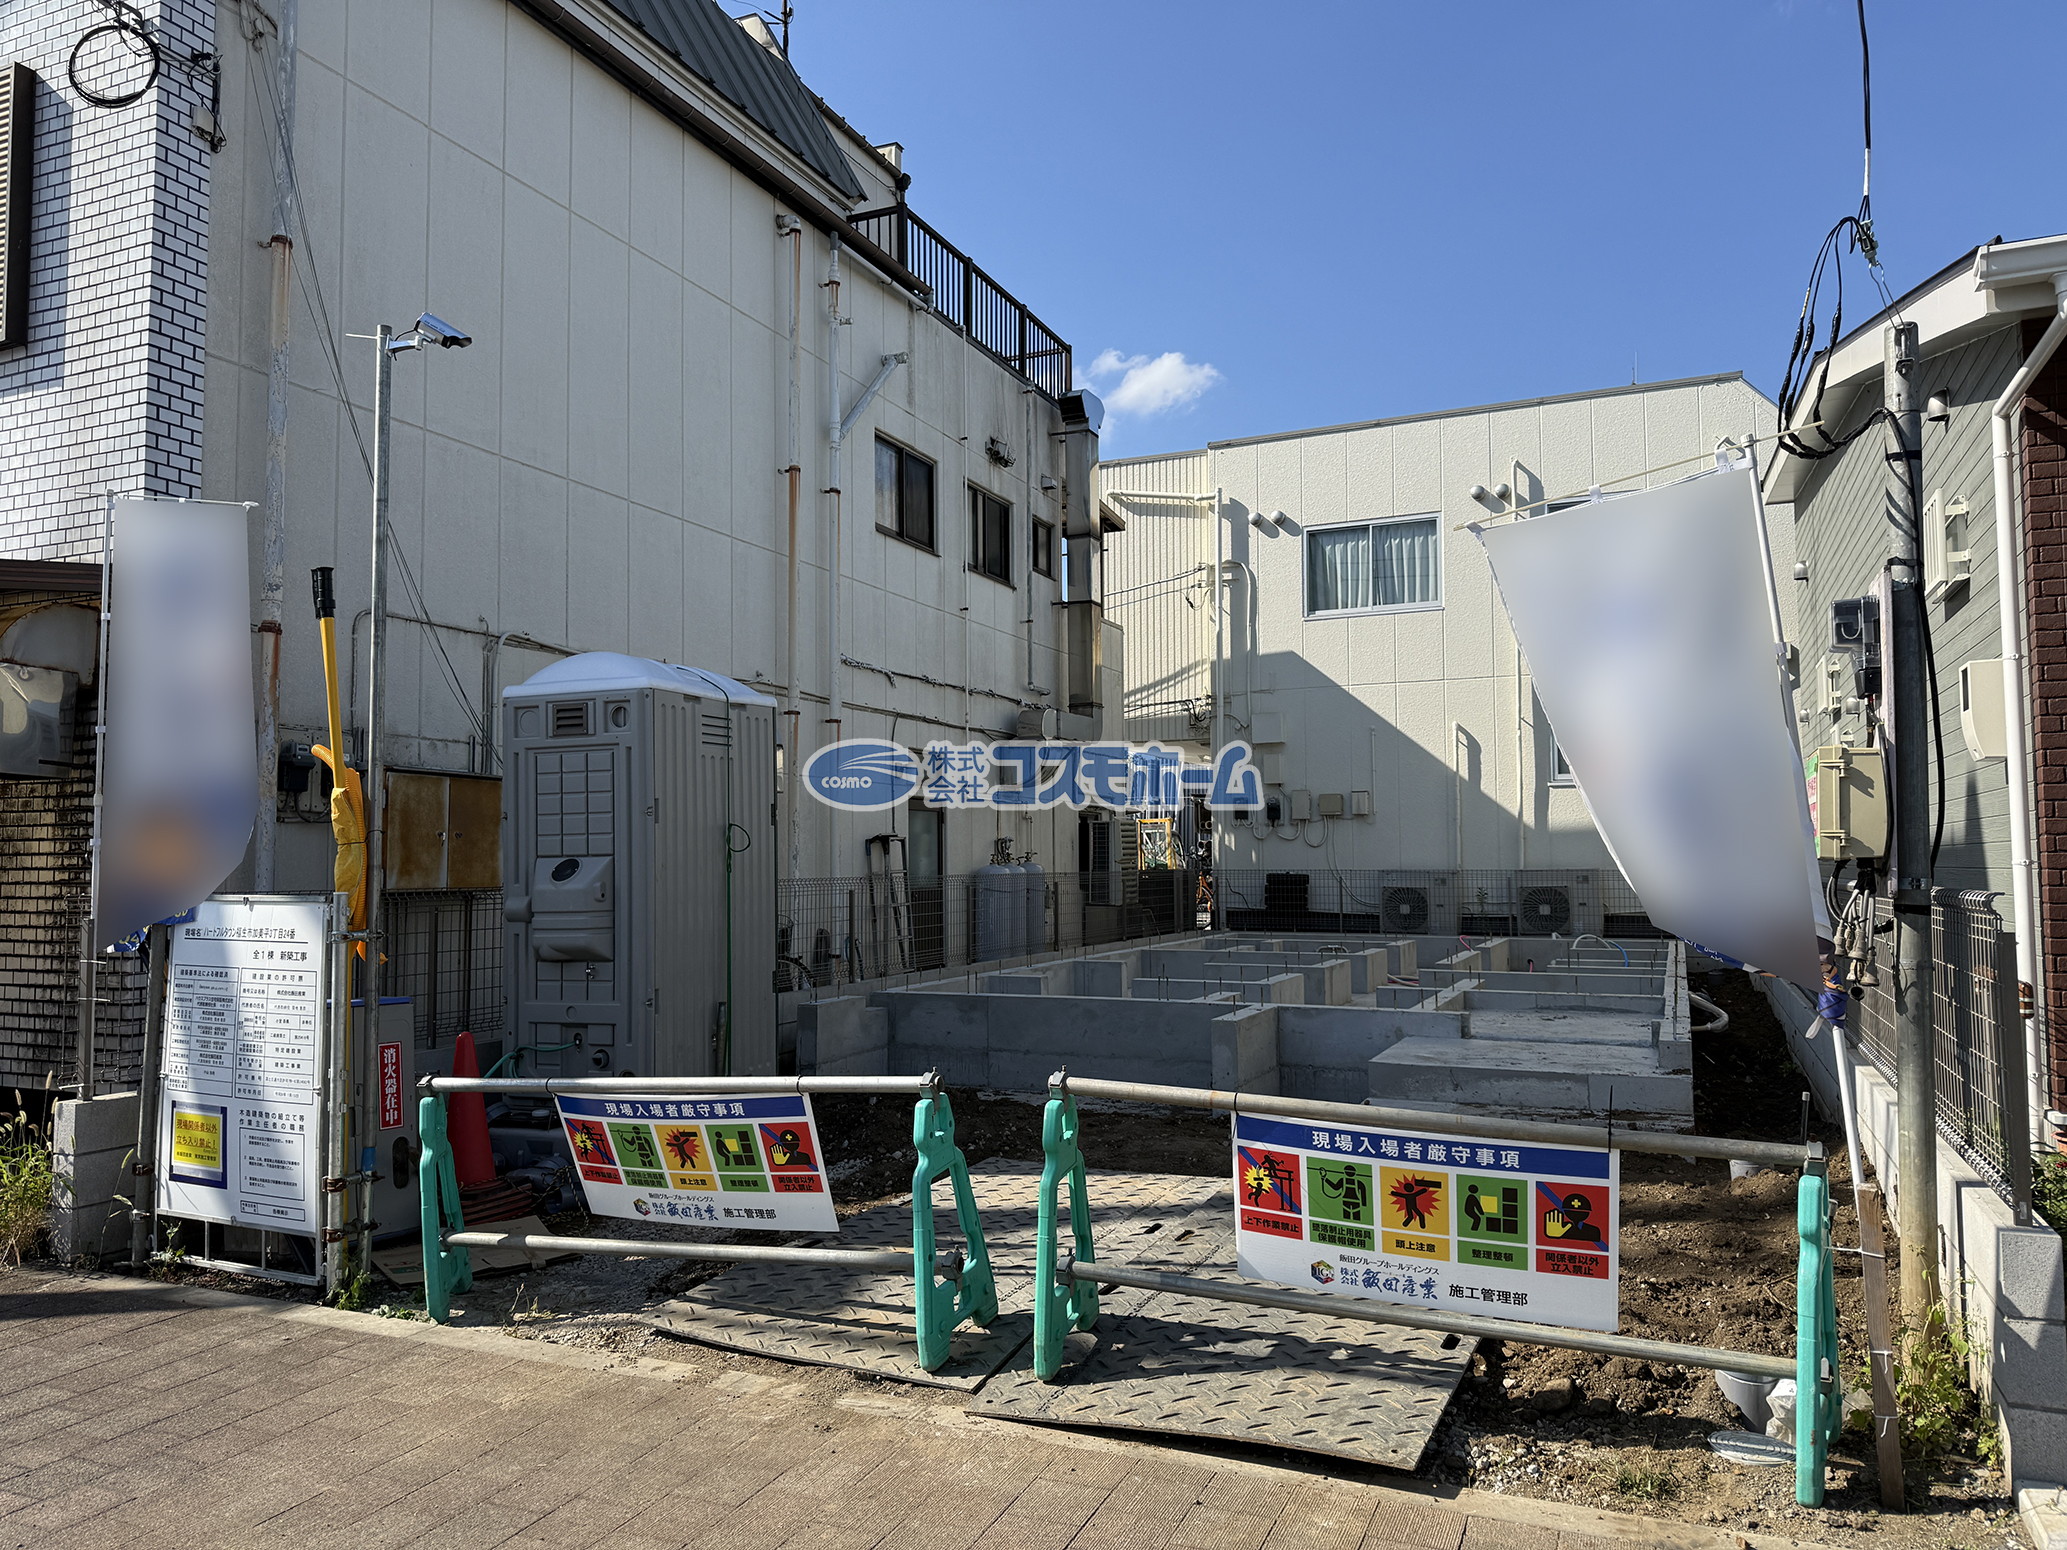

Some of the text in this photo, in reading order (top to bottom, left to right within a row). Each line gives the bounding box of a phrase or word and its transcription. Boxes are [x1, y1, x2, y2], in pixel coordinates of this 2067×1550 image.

[280, 950, 308, 962] 新築工事
[383, 1047, 398, 1125] 消火器在中
[604, 1102, 746, 1118] 現場入場者厳守事項
[1312, 1130, 1521, 1169] 現場入場者厳守事項
[723, 1207, 777, 1219] 施工管理部
[1244, 1216, 1300, 1233] 上下作業禁止
[1317, 1232, 1367, 1249] 保護帽使用
[1395, 1239, 1436, 1253] 頭上注意
[1471, 1248, 1514, 1262] 整理整頓
[1545, 1252, 1600, 1267] 関係者以外
[1339, 1253, 1440, 1276] 飯田グループホールディングス
[1551, 1263, 1595, 1276] 立入禁止
[1448, 1283, 1529, 1307] 施工管理部
